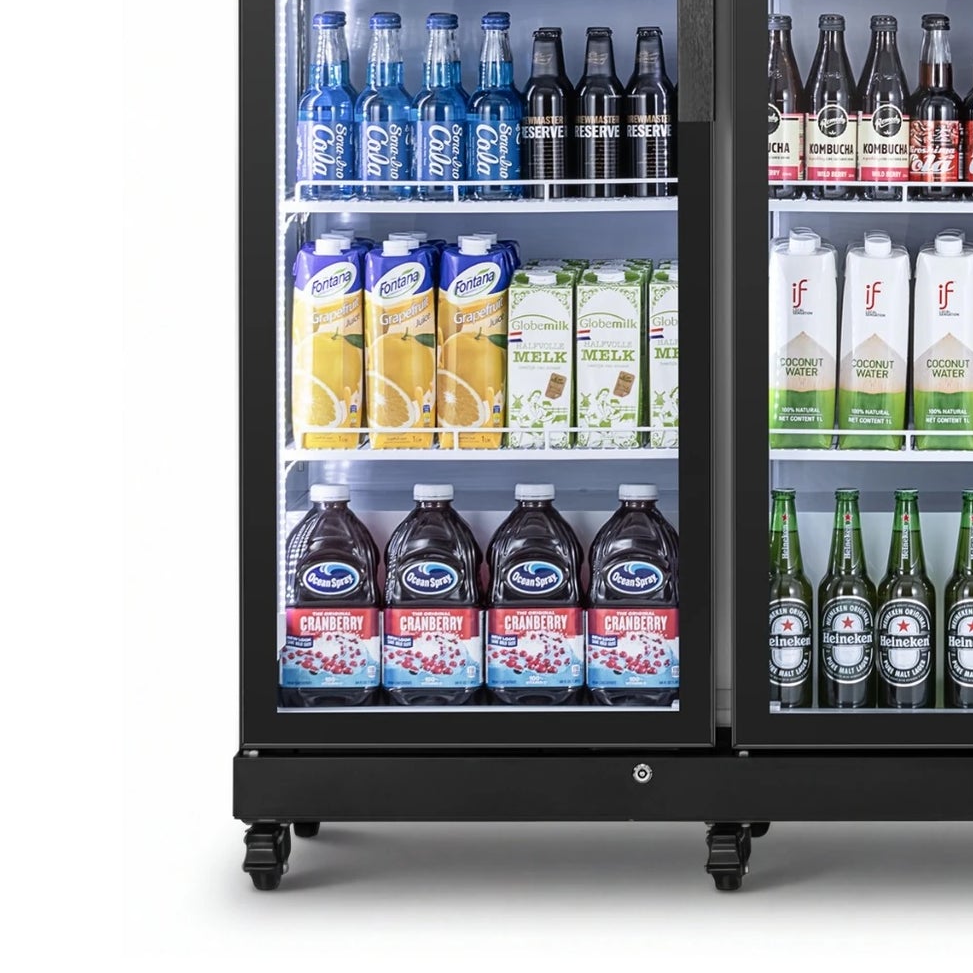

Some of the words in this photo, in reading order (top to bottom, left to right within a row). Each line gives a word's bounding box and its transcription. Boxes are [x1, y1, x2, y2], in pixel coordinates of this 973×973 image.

[575, 125, 620, 138] RESERVE
[627, 124, 671, 138] RESERVE
[312, 124, 336, 176] Cola
[366, 124, 390, 177] Cola
[428, 125, 452, 176] Cola
[476, 124, 499, 176] Cola
[809, 143, 854, 155] KOMBUCHA
[863, 143, 908, 155] KOMBUCHA
[311, 270, 351, 295] Fontana
[379, 271, 419, 296] Fontana
[454, 271, 495, 295] Fontana
[793, 279, 808, 308] if
[866, 281, 881, 310] if
[939, 281, 954, 310] if
[312, 297, 359, 325] Grapefruit
[380, 298, 429, 326] Grapefruit
[454, 297, 503, 325] Grapefruit
[511, 320, 569, 331] Globemilk
[579, 318, 637, 330] Globemilk
[513, 351, 567, 363] MELK
[581, 349, 635, 361] MELK
[780, 358, 823, 367] COCONUT
[851, 359, 894, 369] COCONUT
[926, 358, 969, 368] COCONUT
[785, 367, 818, 377] WATER
[856, 368, 888, 378] WATER
[932, 368, 964, 378] WATER
[308, 572, 332, 588] Ocean
[331, 576, 354, 589] Spray
[407, 572, 431, 588] Ocean
[430, 576, 454, 589] Spray
[512, 571, 536, 587] Ocean
[535, 576, 558, 588] Spray
[612, 572, 636, 588] Ocean
[635, 576, 659, 588] Spray
[301, 616, 364, 631] CRANBERRY
[400, 616, 463, 631] CRANBERRY
[504, 615, 567, 631] CRANBERRY
[604, 616, 667, 631] CRANBERRY
[823, 633, 872, 644] Heineken
[879, 635, 929, 647] Heineken
